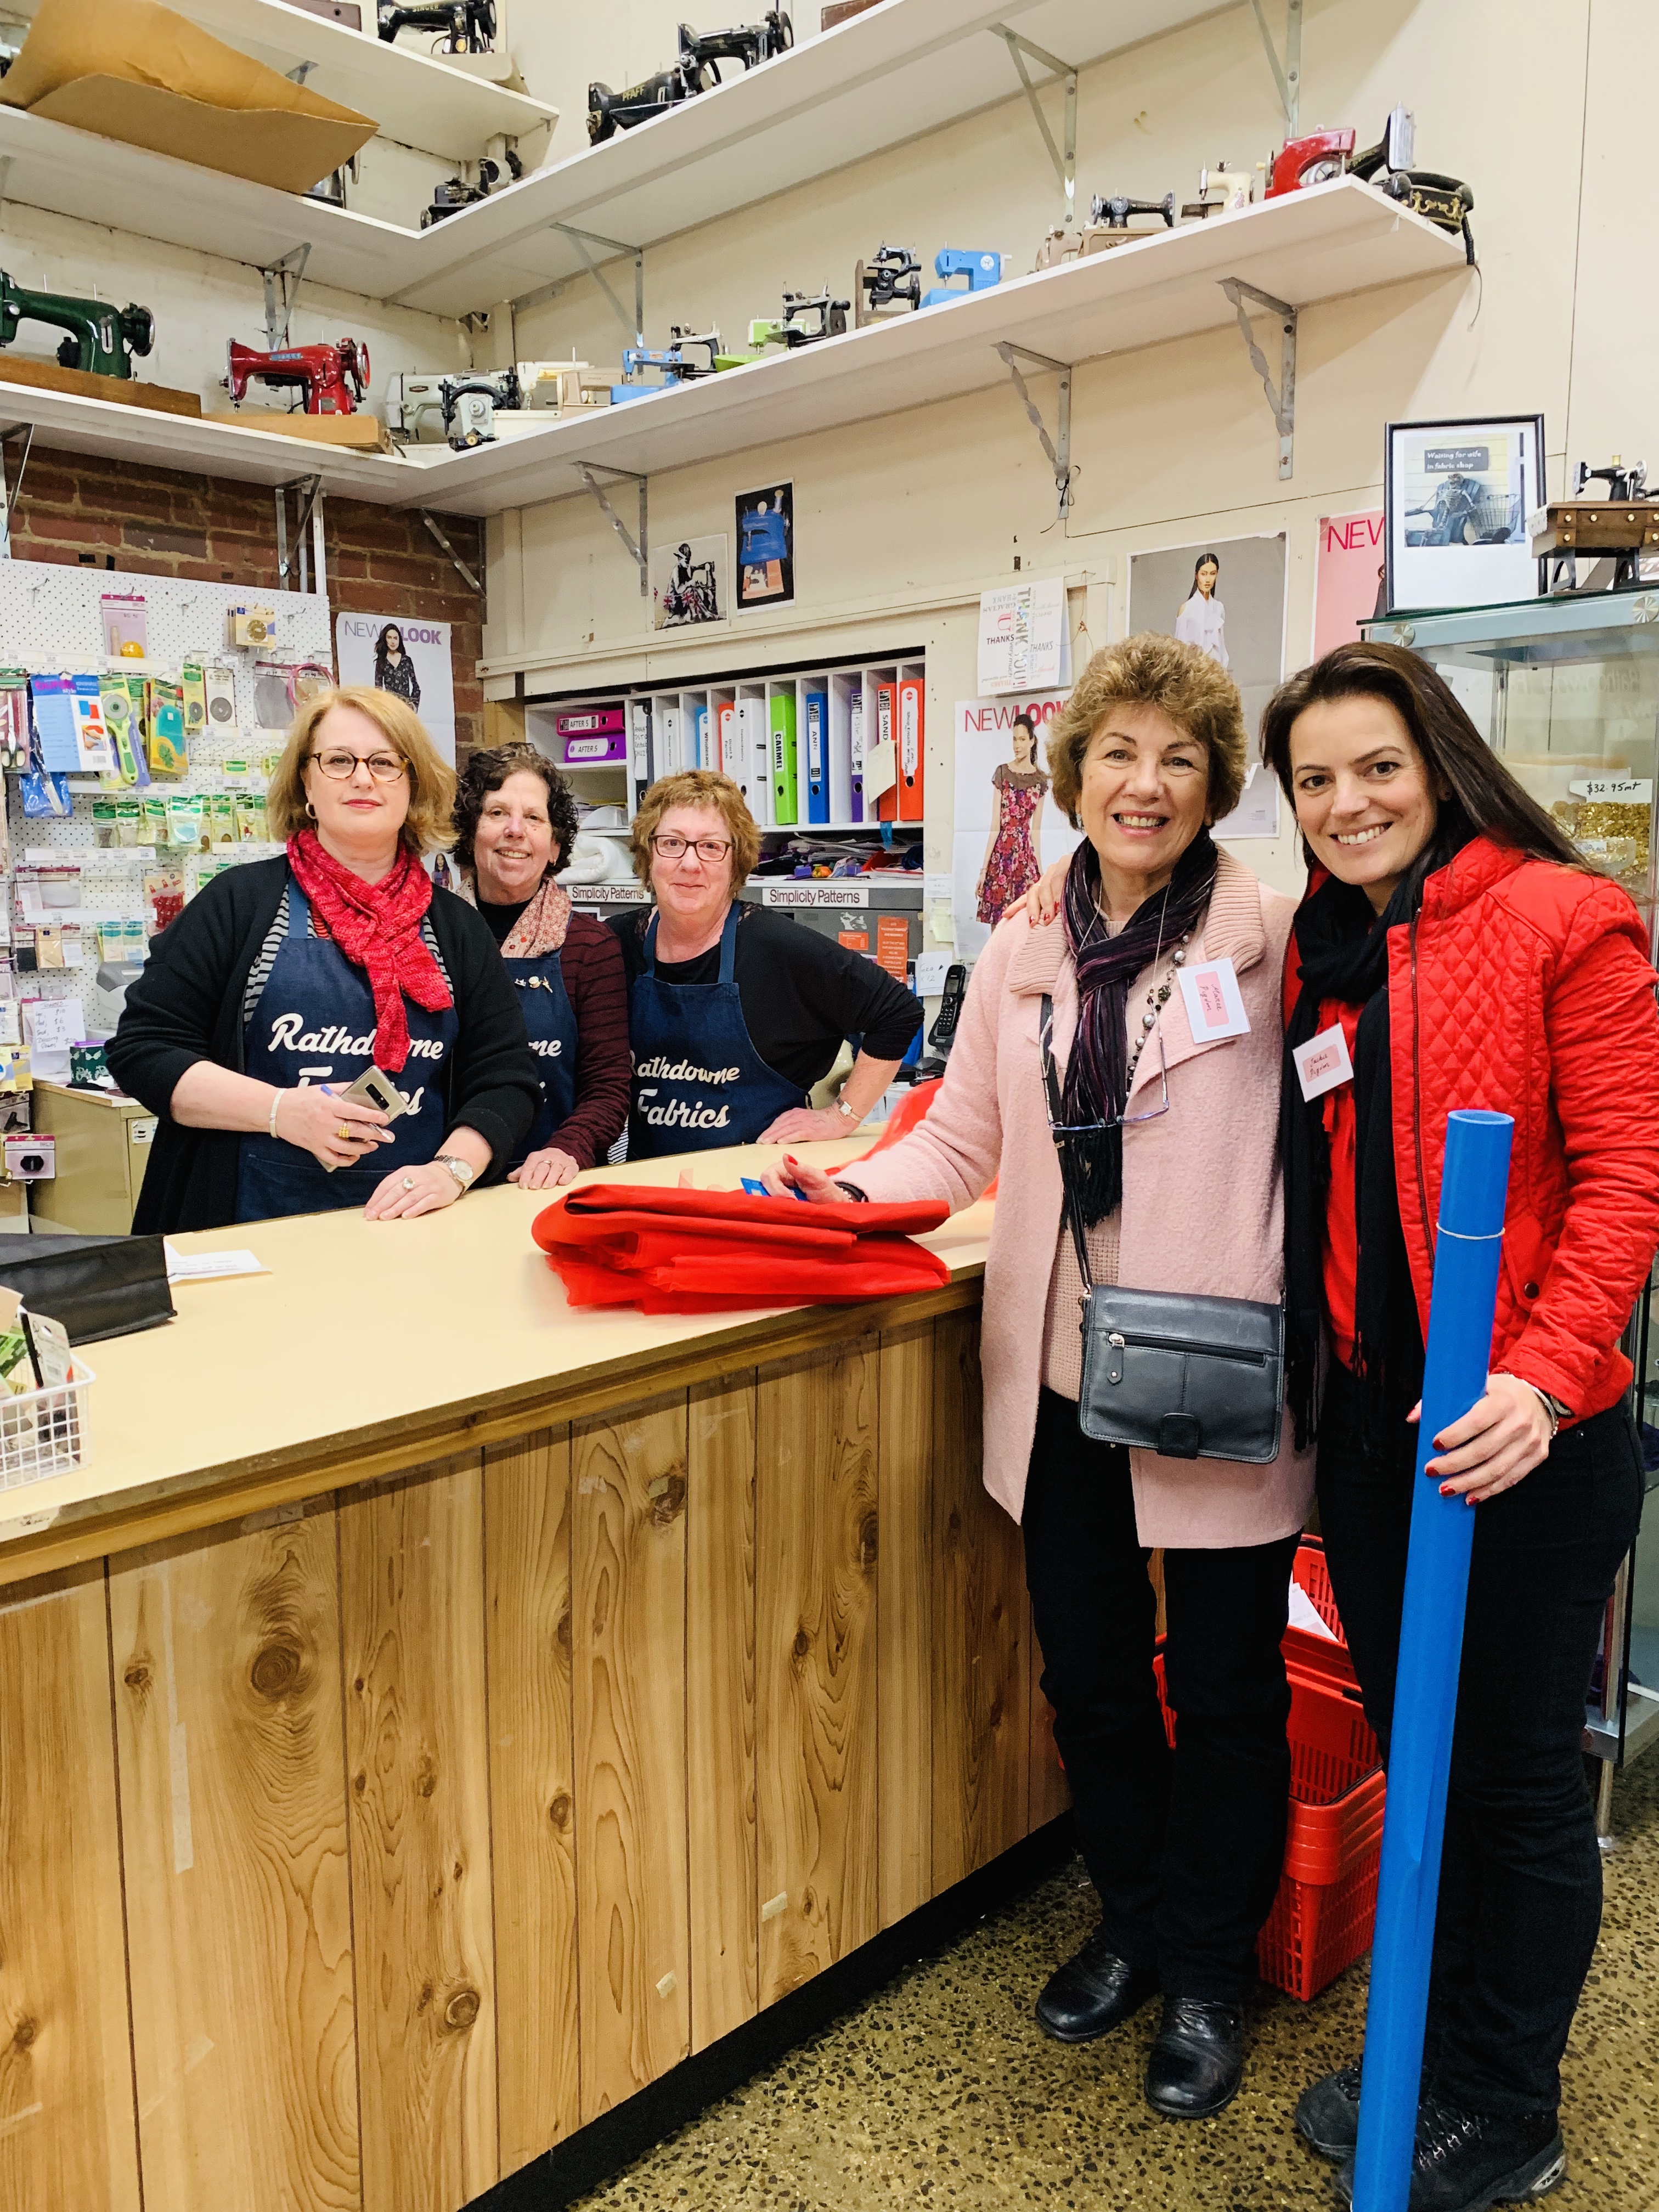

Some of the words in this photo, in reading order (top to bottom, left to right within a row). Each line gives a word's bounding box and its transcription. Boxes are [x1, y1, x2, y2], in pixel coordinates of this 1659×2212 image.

[622, 84, 645, 101] PFAFF
[1456, 461, 1474, 470] shop
[1015, 587, 1031, 646] THANK
[345, 620, 382, 637] NEW
[400, 627, 442, 645] LOOK
[986, 634, 1014, 645] THANKS
[1030, 641, 1053, 653] THANKS
[965, 706, 1015, 732] NEW
[572, 886, 609, 901] Simplicity
[611, 887, 644, 900] Patterns
[770, 889, 816, 905] Simplicity
[818, 890, 860, 904] Patterns
[267, 1013, 444, 1060] Rathdne
[637, 1088, 731, 1129] Fabrics
